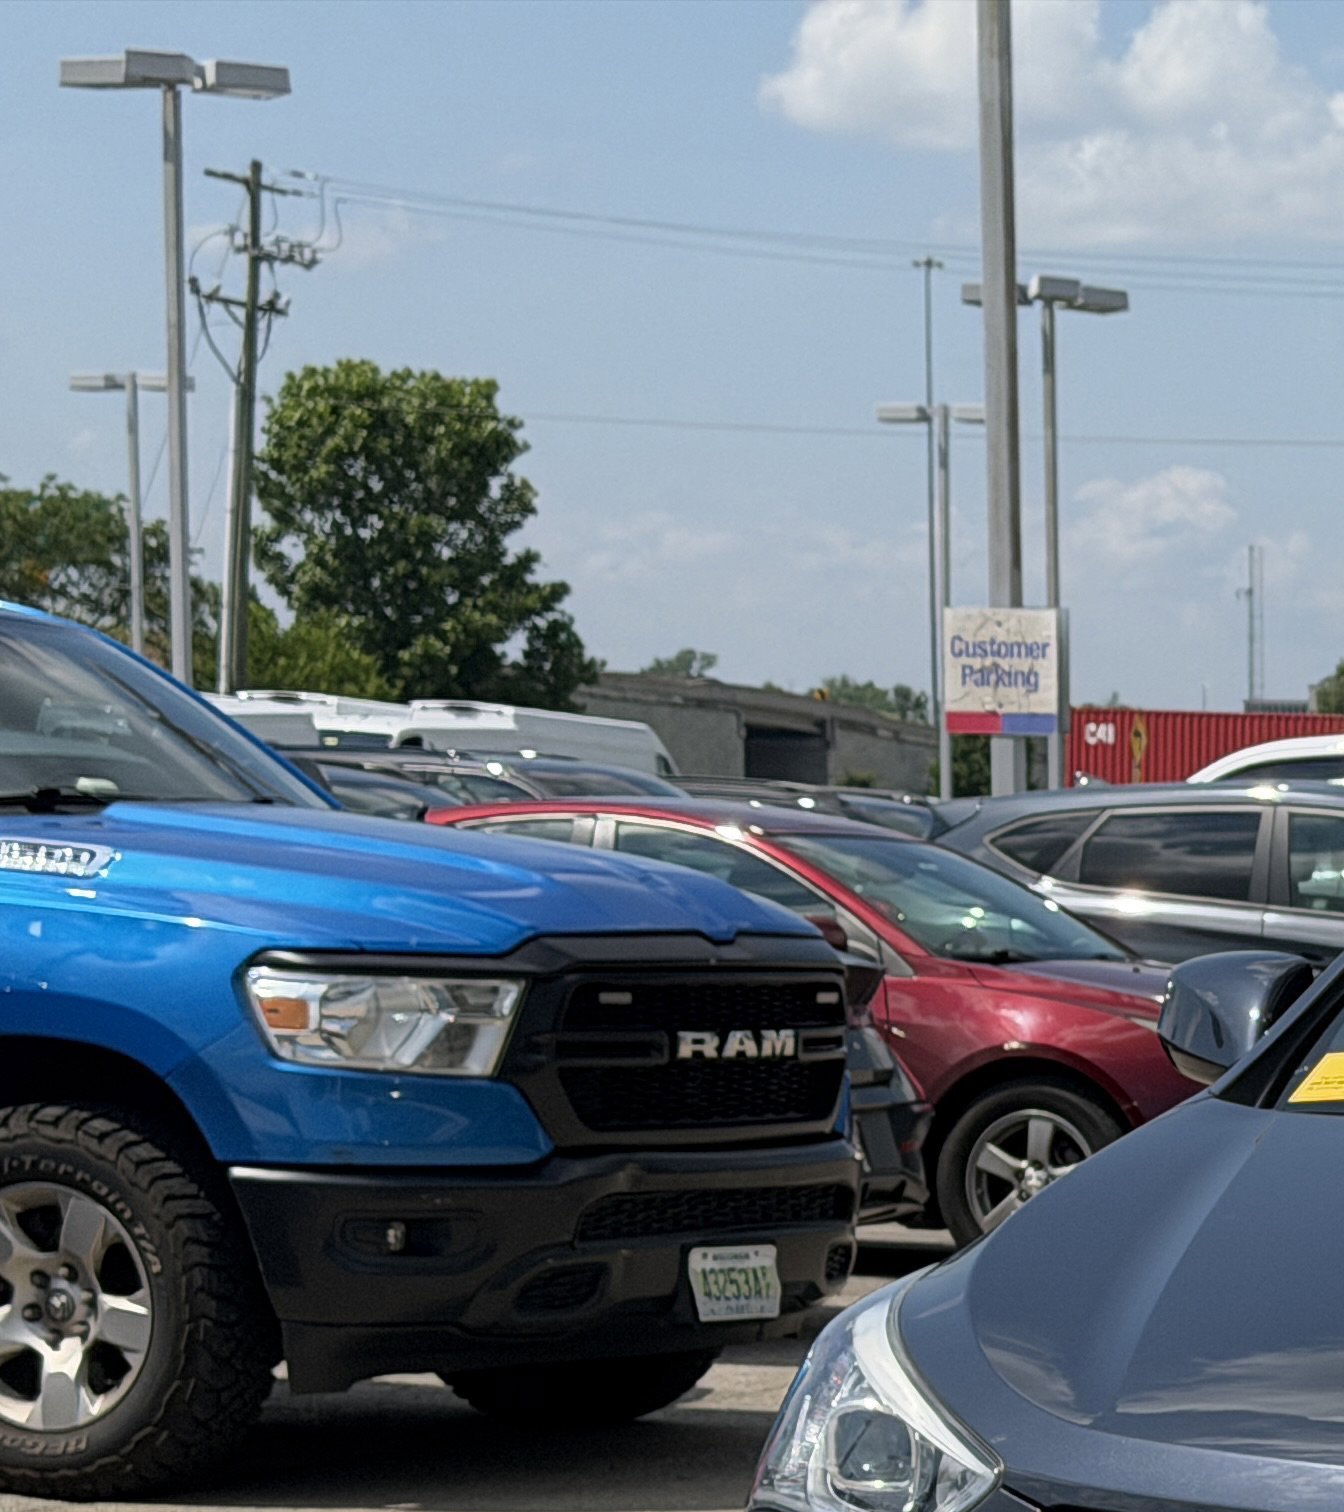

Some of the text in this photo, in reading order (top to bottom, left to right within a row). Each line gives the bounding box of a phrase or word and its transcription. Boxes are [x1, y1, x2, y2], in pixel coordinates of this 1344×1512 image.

[950, 635, 1050, 660] Customer
[961, 664, 1039, 693] Parking
[677, 1029, 795, 1058] RAM
